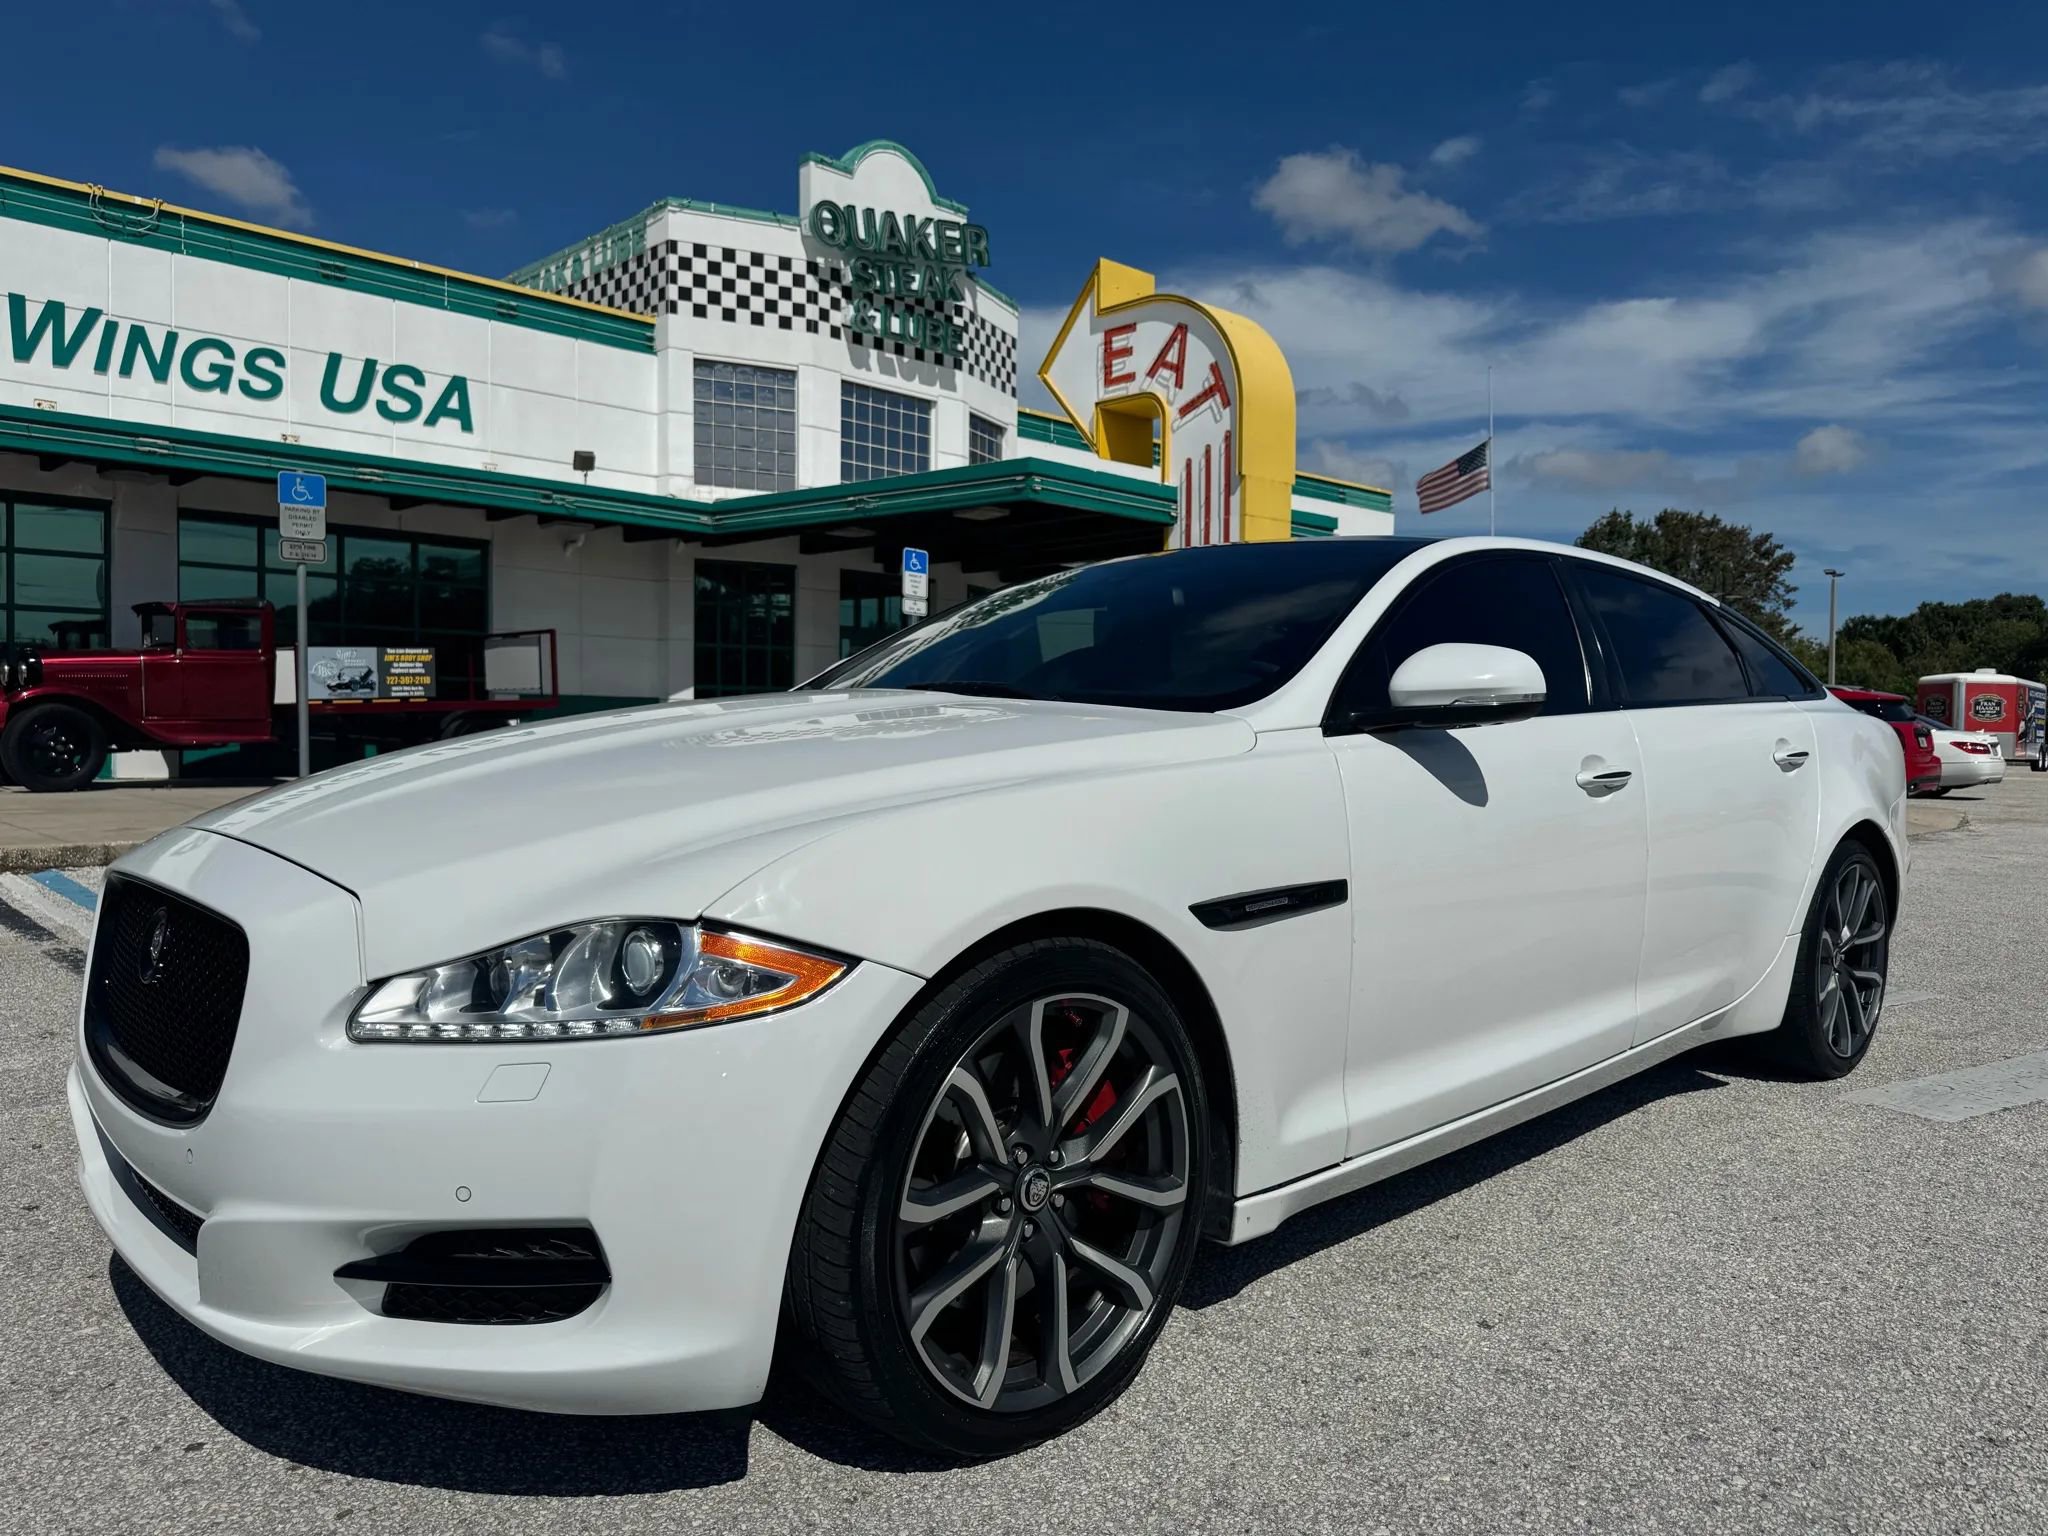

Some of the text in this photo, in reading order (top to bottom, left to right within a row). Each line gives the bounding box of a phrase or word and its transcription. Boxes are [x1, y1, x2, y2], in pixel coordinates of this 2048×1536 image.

[809, 200, 991, 267] QUAKER
[851, 257, 966, 303] STEAK
[852, 298, 964, 358] & LUBE
[8, 292, 474, 434] WINGS USA
[1104, 322, 1231, 418] EAT
